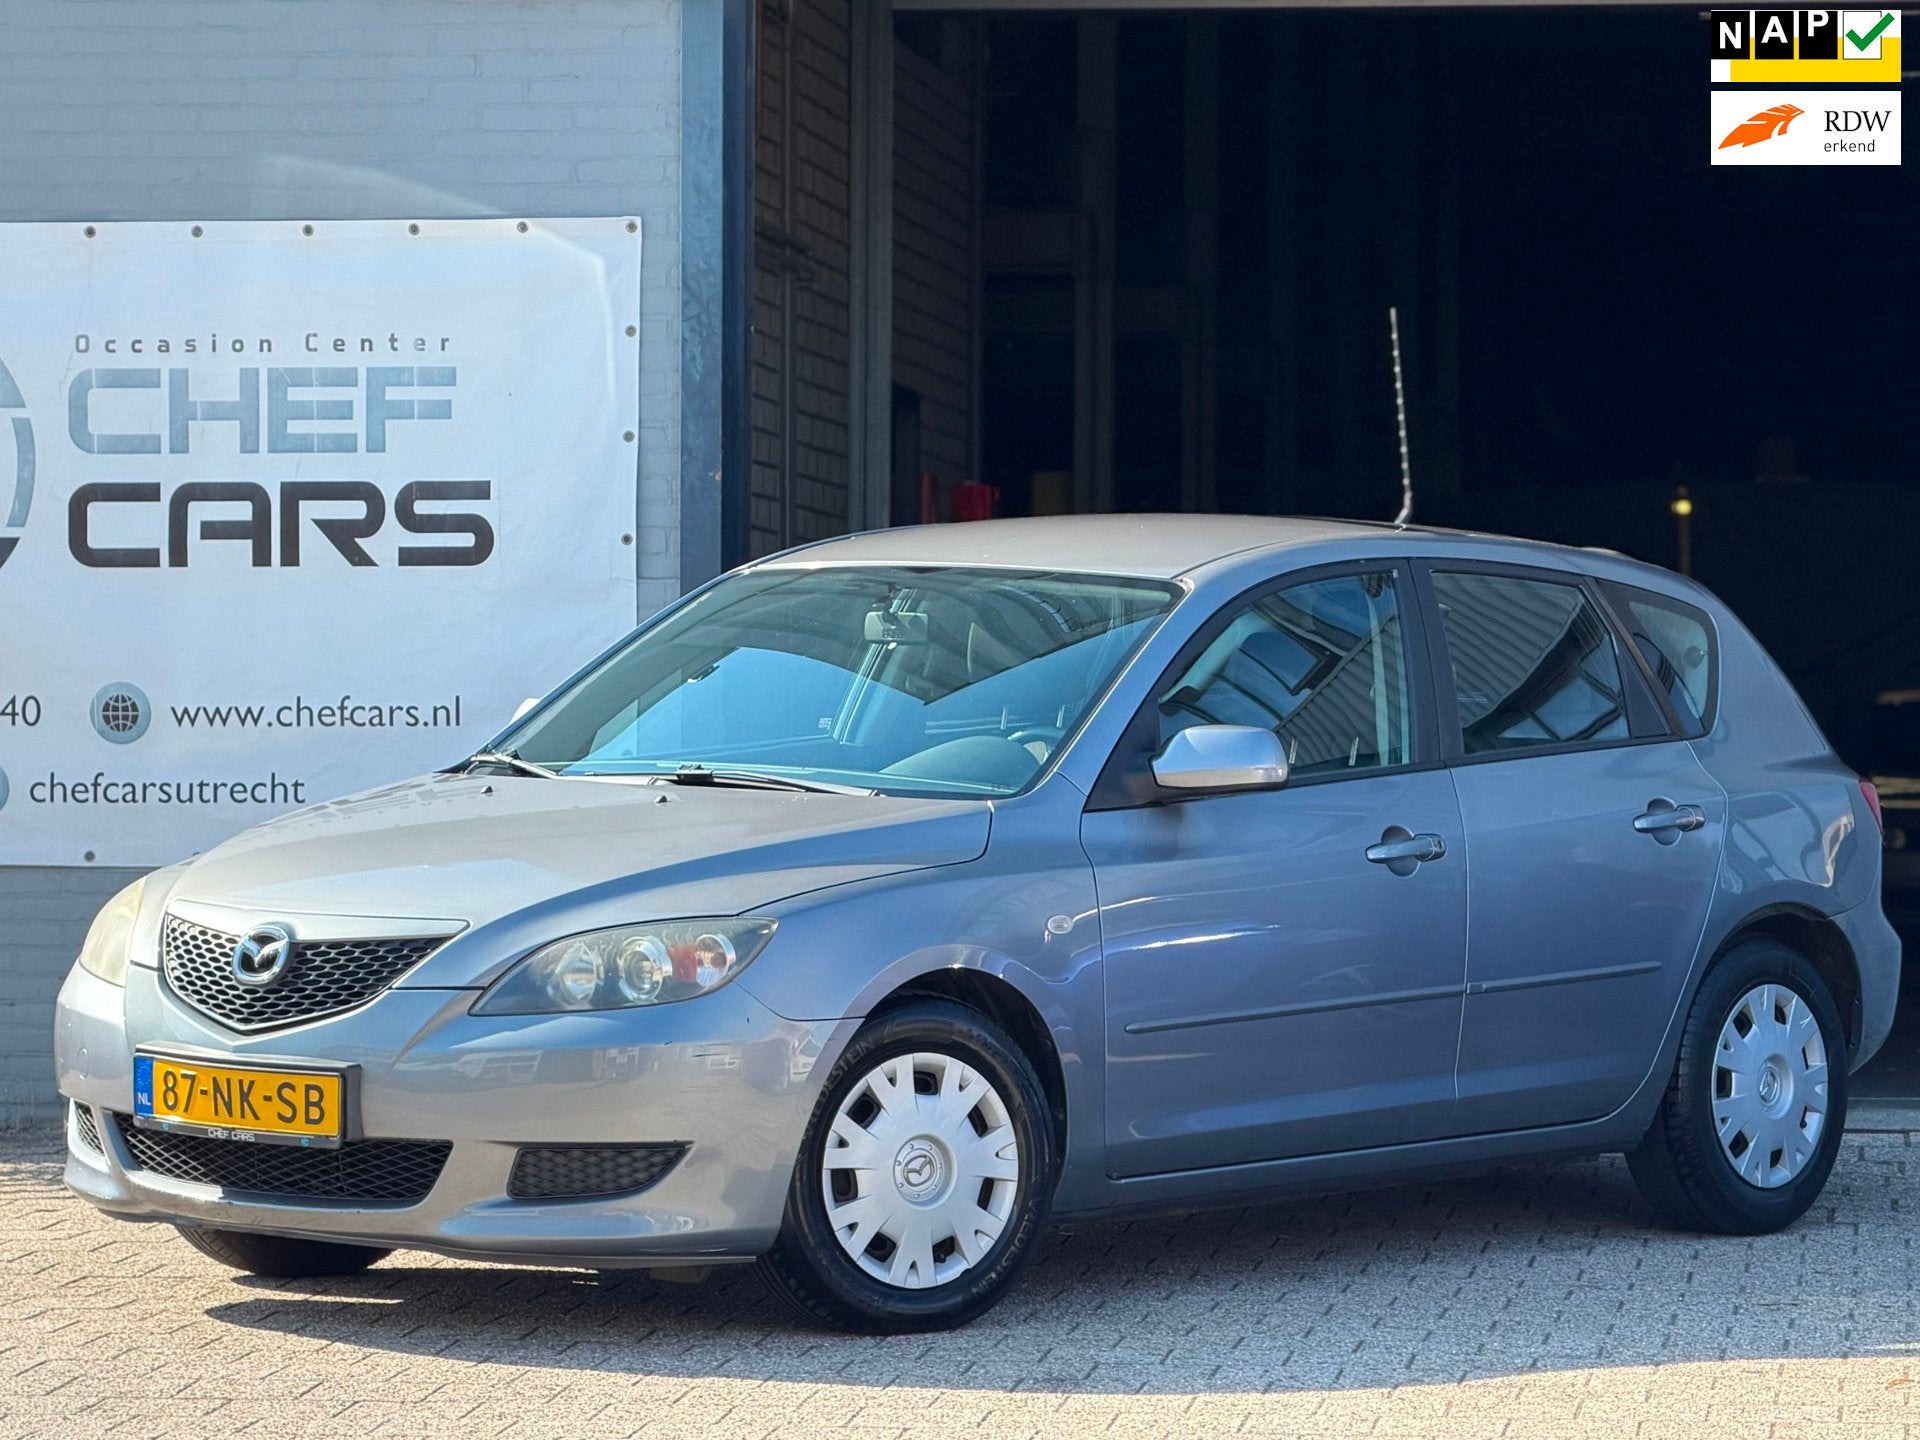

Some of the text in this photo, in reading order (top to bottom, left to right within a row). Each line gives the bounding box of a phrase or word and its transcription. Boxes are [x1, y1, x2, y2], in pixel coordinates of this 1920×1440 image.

[75, 333, 452, 353] Occasion Center
[68, 366, 457, 454] CHEF
[68, 480, 495, 567] CARS
[0, 694, 41, 727] 40
[170, 695, 461, 728] www.chefcars.nl
[29, 773, 306, 804] chefcarsutrecht
[138, 1092, 152, 1106] NL
[163, 1070, 326, 1126] 87-NK-SB
